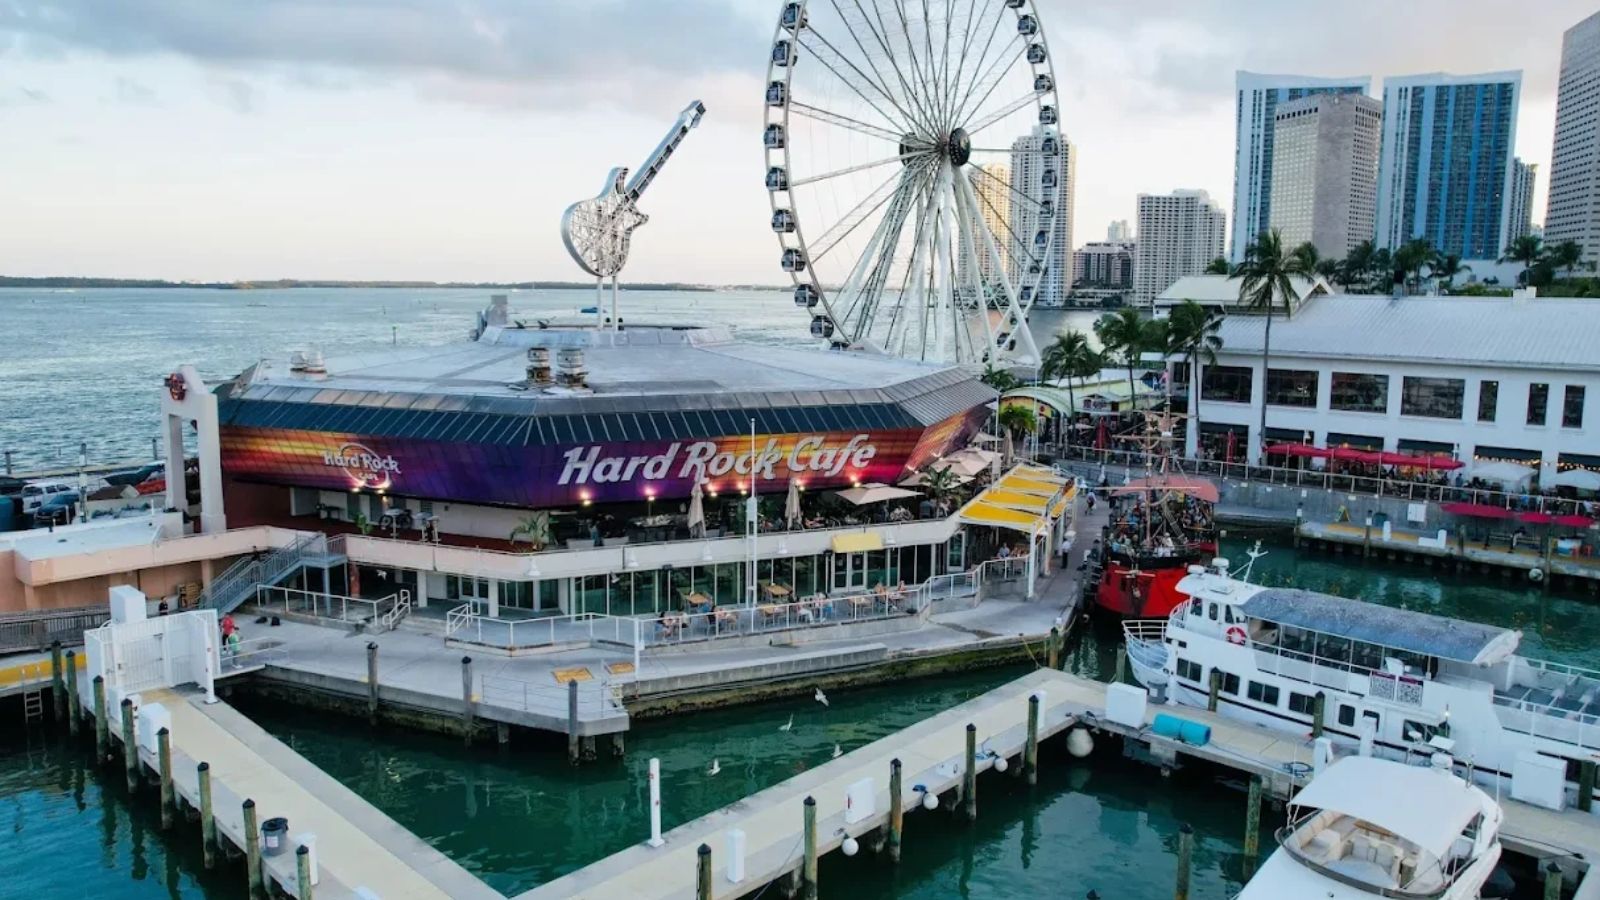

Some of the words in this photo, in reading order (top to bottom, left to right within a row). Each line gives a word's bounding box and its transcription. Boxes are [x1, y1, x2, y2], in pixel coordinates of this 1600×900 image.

[323, 449, 360, 467] Hard
[361, 453, 402, 474] Rock
[557, 442, 682, 485] Hard
[678, 438, 783, 485] Rock
[787, 433, 877, 478] Cafe
